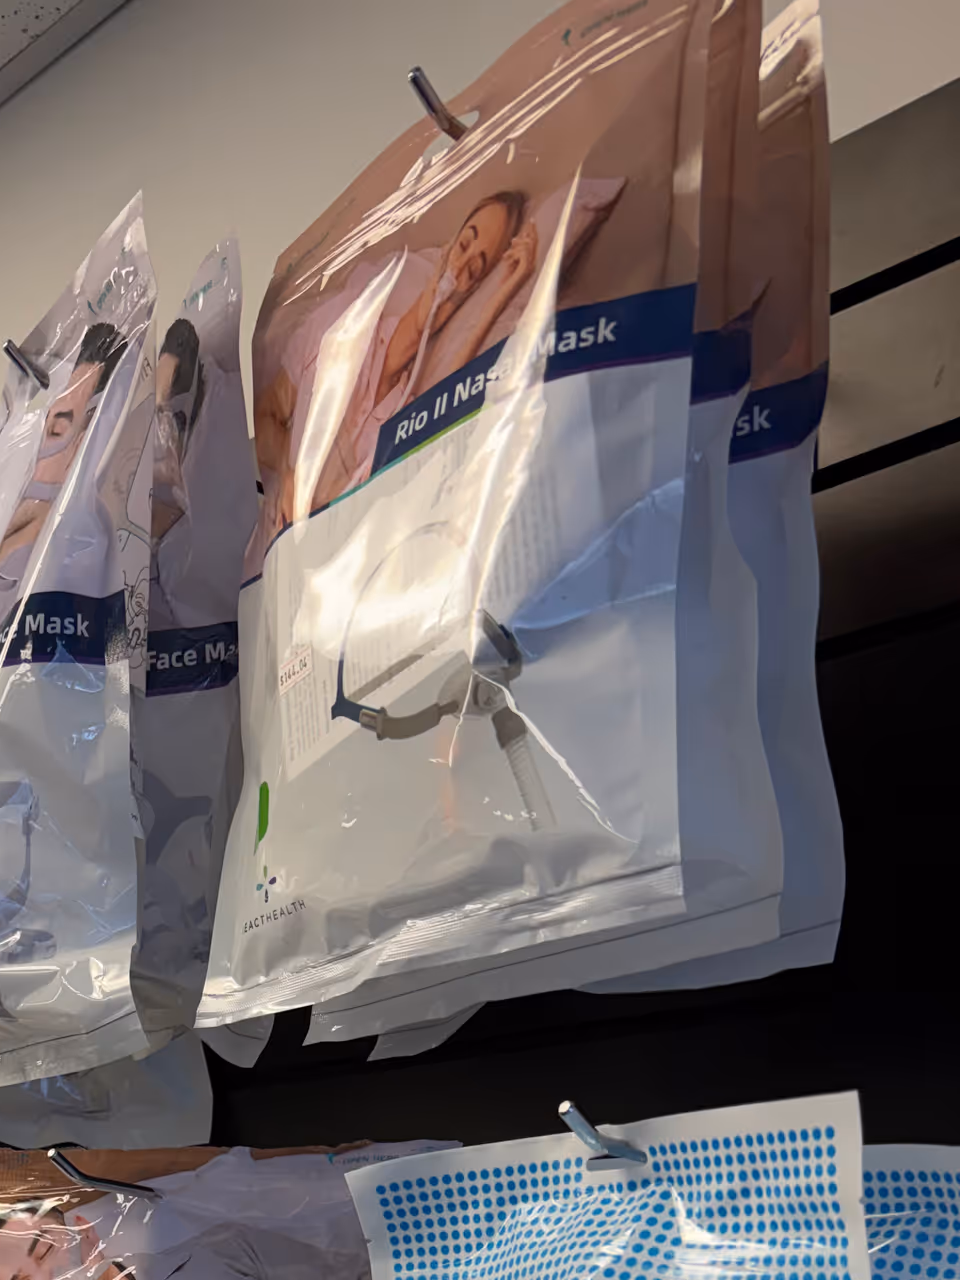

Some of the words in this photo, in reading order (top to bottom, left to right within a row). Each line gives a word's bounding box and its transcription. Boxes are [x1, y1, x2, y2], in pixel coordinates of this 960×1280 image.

[394, 411, 427, 445] Rio
[433, 391, 448, 420] II
[452, 356, 515, 408] Nasa
[531, 315, 617, 359] Mask
[732, 405, 772, 437] sk
[24, 612, 90, 639] Mask
[147, 645, 198, 672] Face
[242, 898, 307, 935] EACTHEALTH
